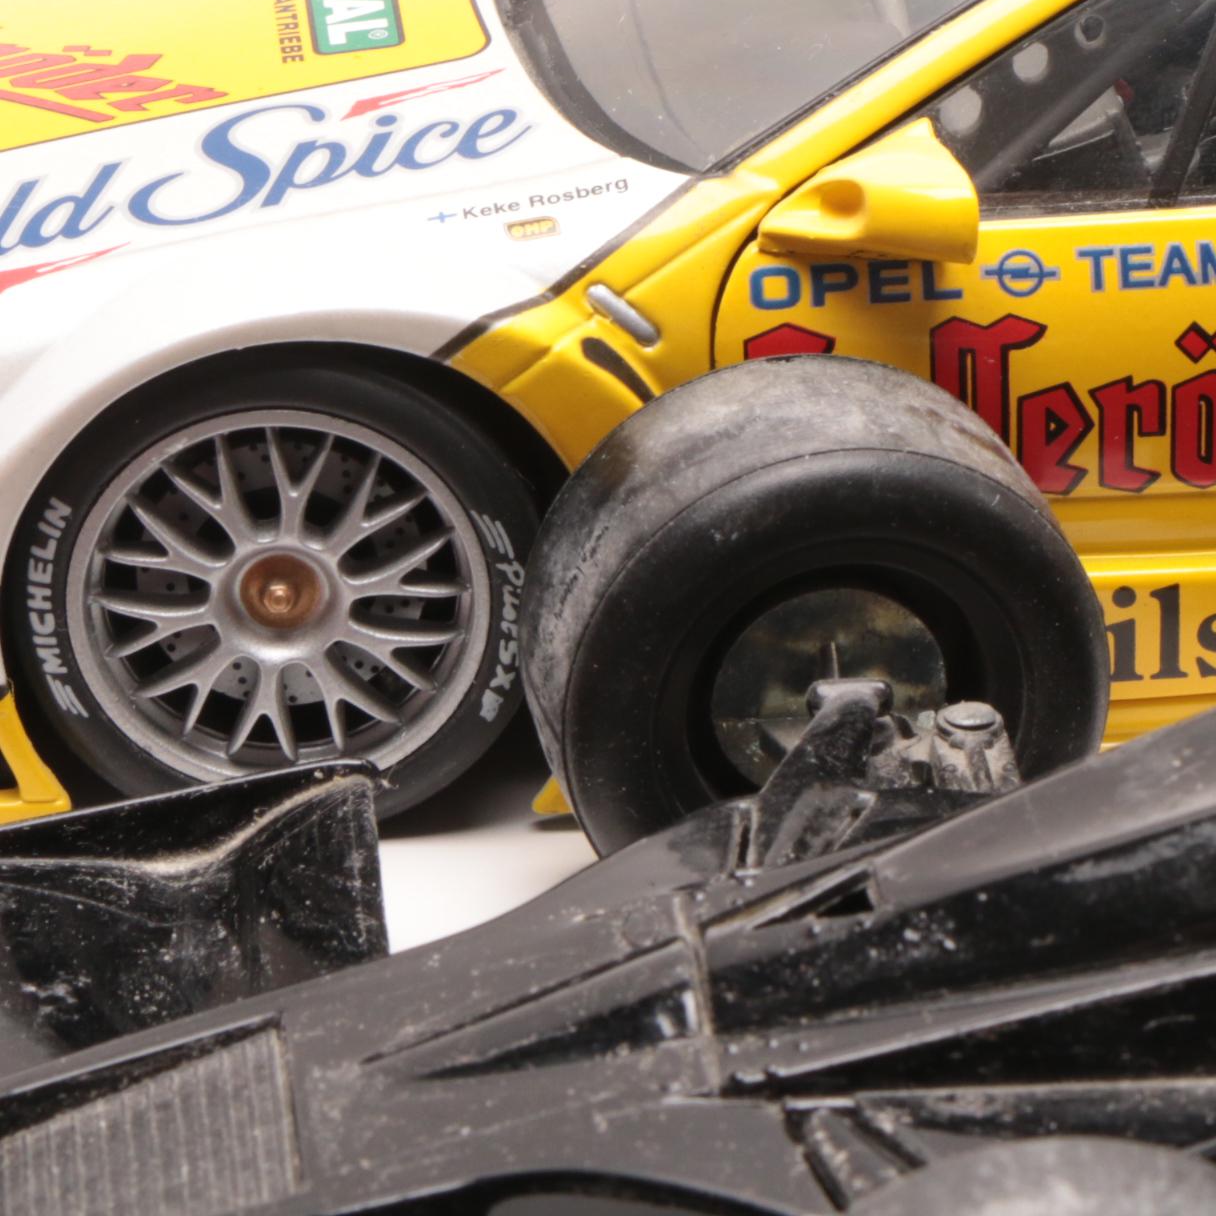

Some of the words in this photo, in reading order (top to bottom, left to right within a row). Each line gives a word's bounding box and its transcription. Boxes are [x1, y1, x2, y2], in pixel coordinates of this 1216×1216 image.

[128, 104, 532, 227] Spice
[462, 201, 521, 220] Keke
[528, 178, 629, 209] Rosberg
[750, 259, 963, 311] OPEL
[27, 496, 73, 675] MICHELIN
